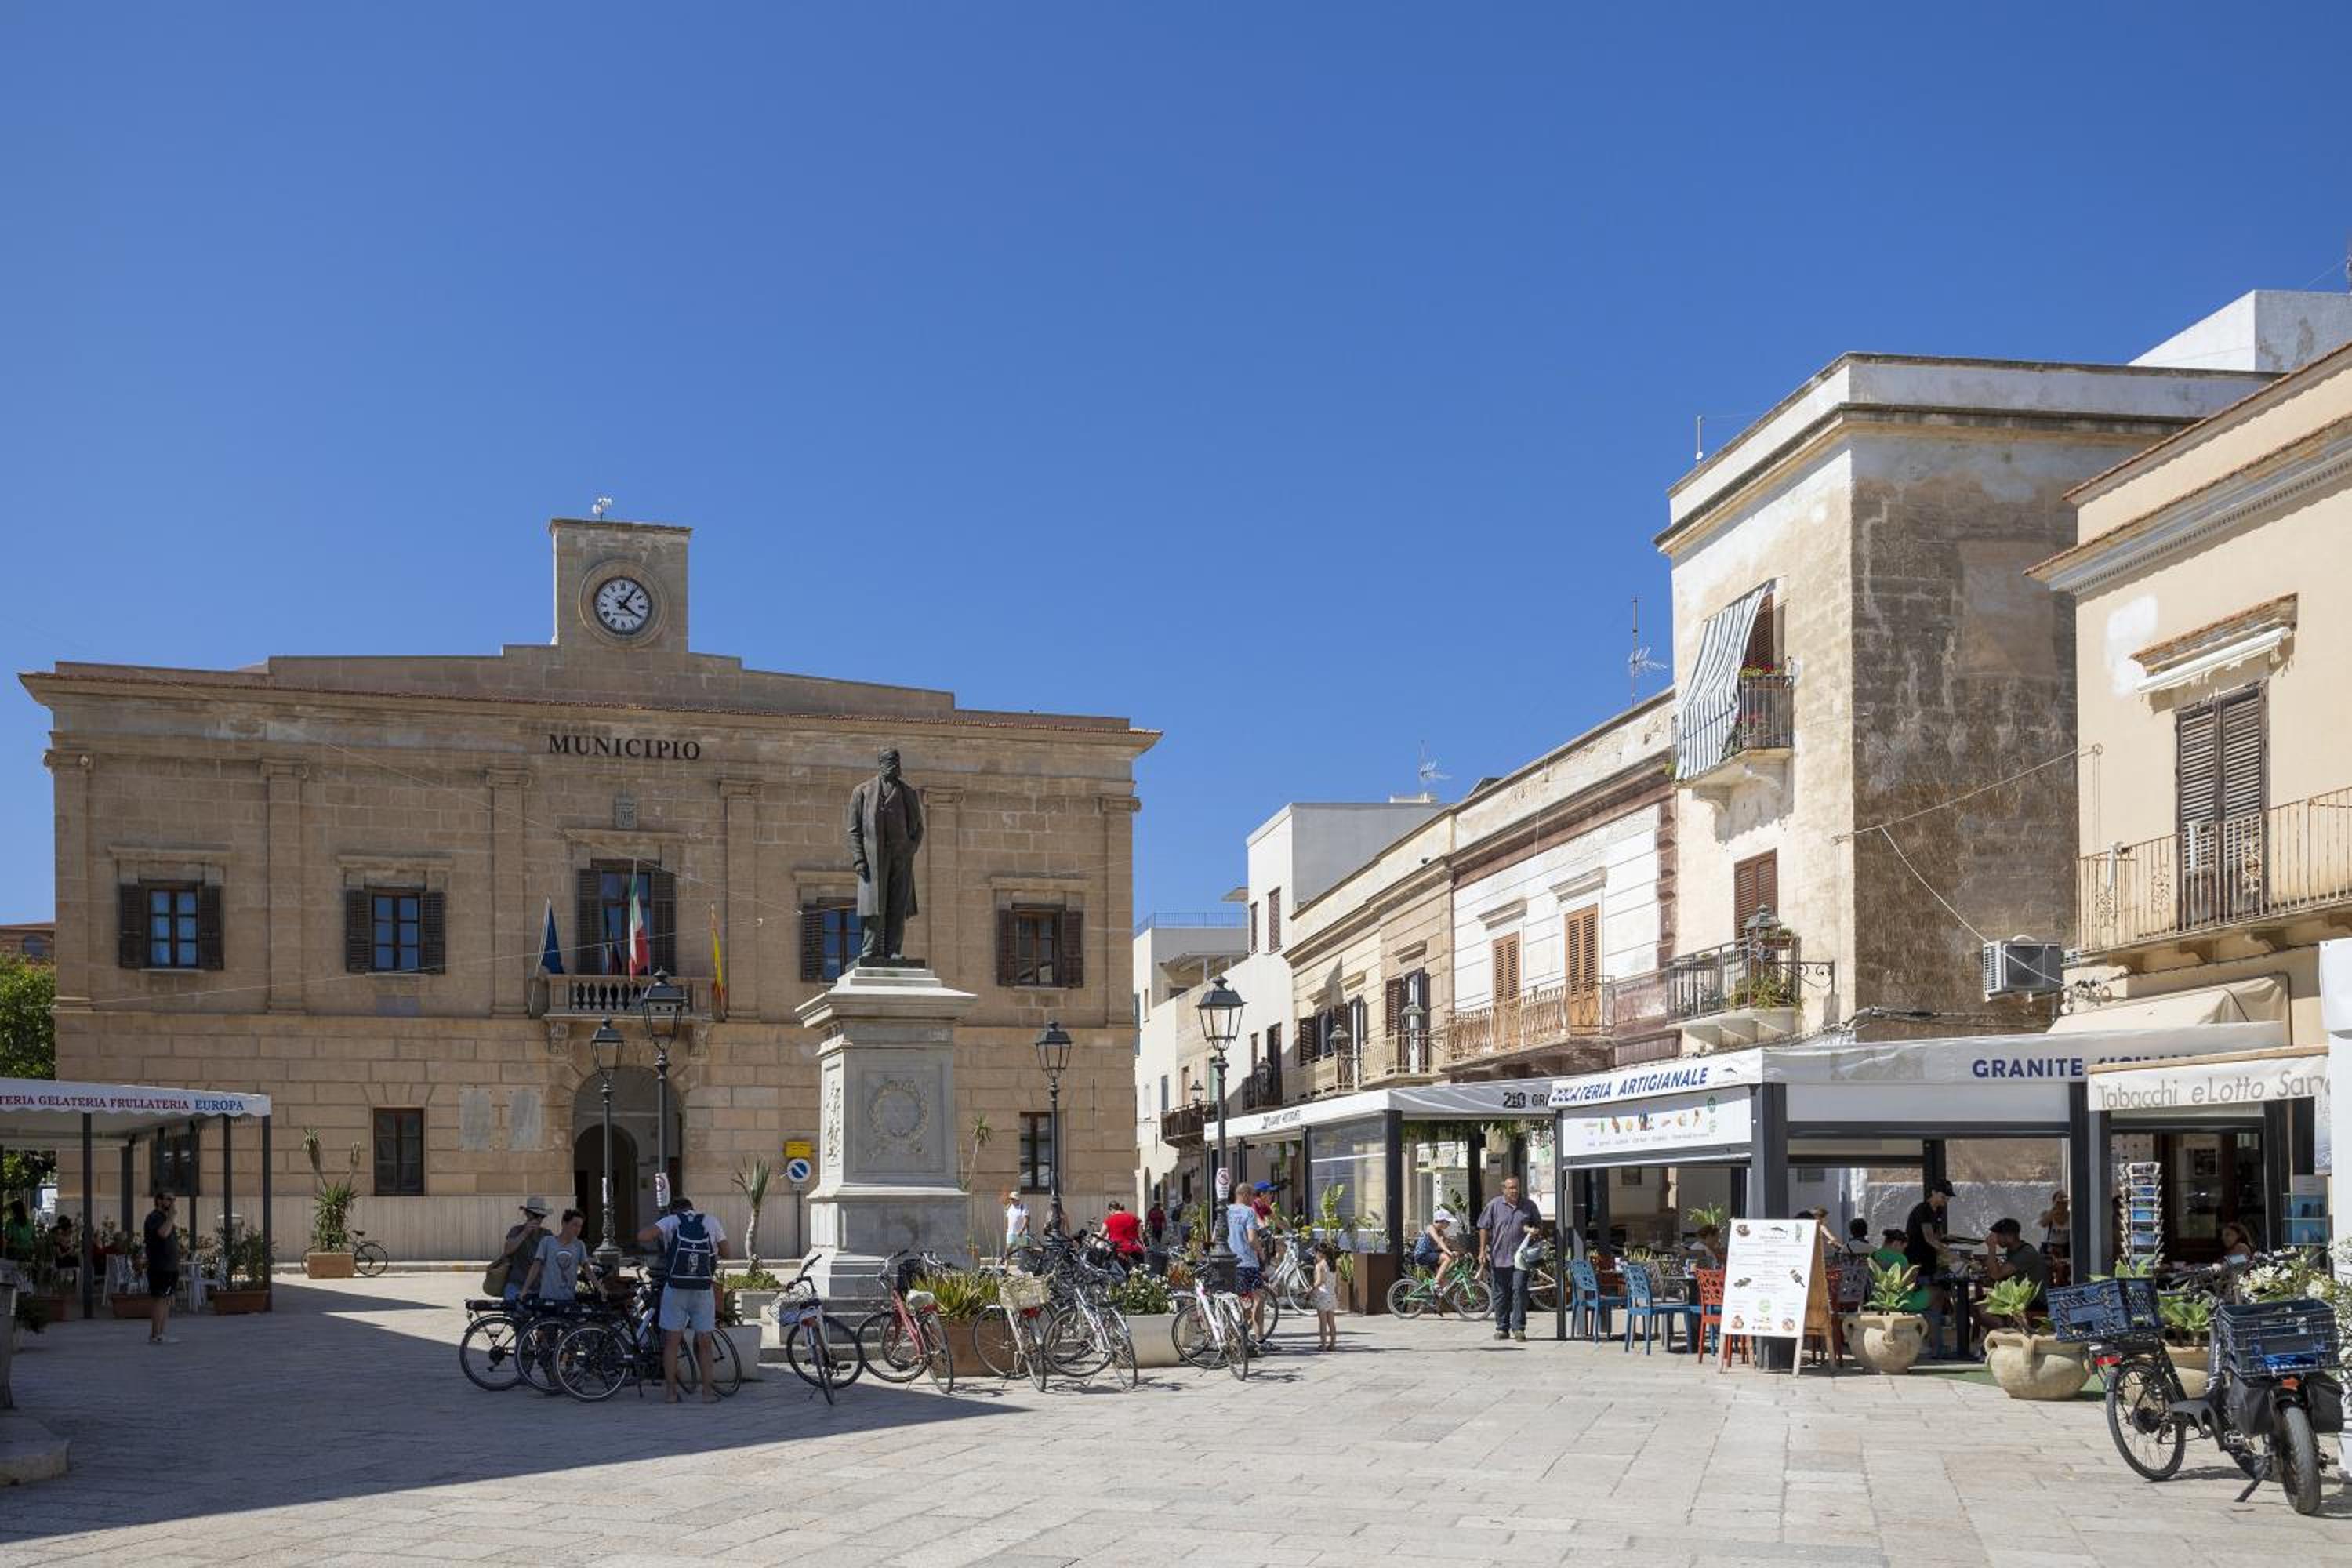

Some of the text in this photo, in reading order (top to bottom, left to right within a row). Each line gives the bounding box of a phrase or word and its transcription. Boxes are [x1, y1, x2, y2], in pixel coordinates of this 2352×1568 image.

[550, 734, 701, 760] MUNICIPIO
[1972, 1058, 2083, 1078] GRANITE
[1618, 1067, 1709, 1097] ARTIGIANALE
[2097, 1079, 2179, 1109] Tabacchi
[39, 1096, 107, 1108] GELATERIA
[111, 1098, 189, 1110] FRULLATERIA
[194, 1099, 245, 1112] EUROPA
